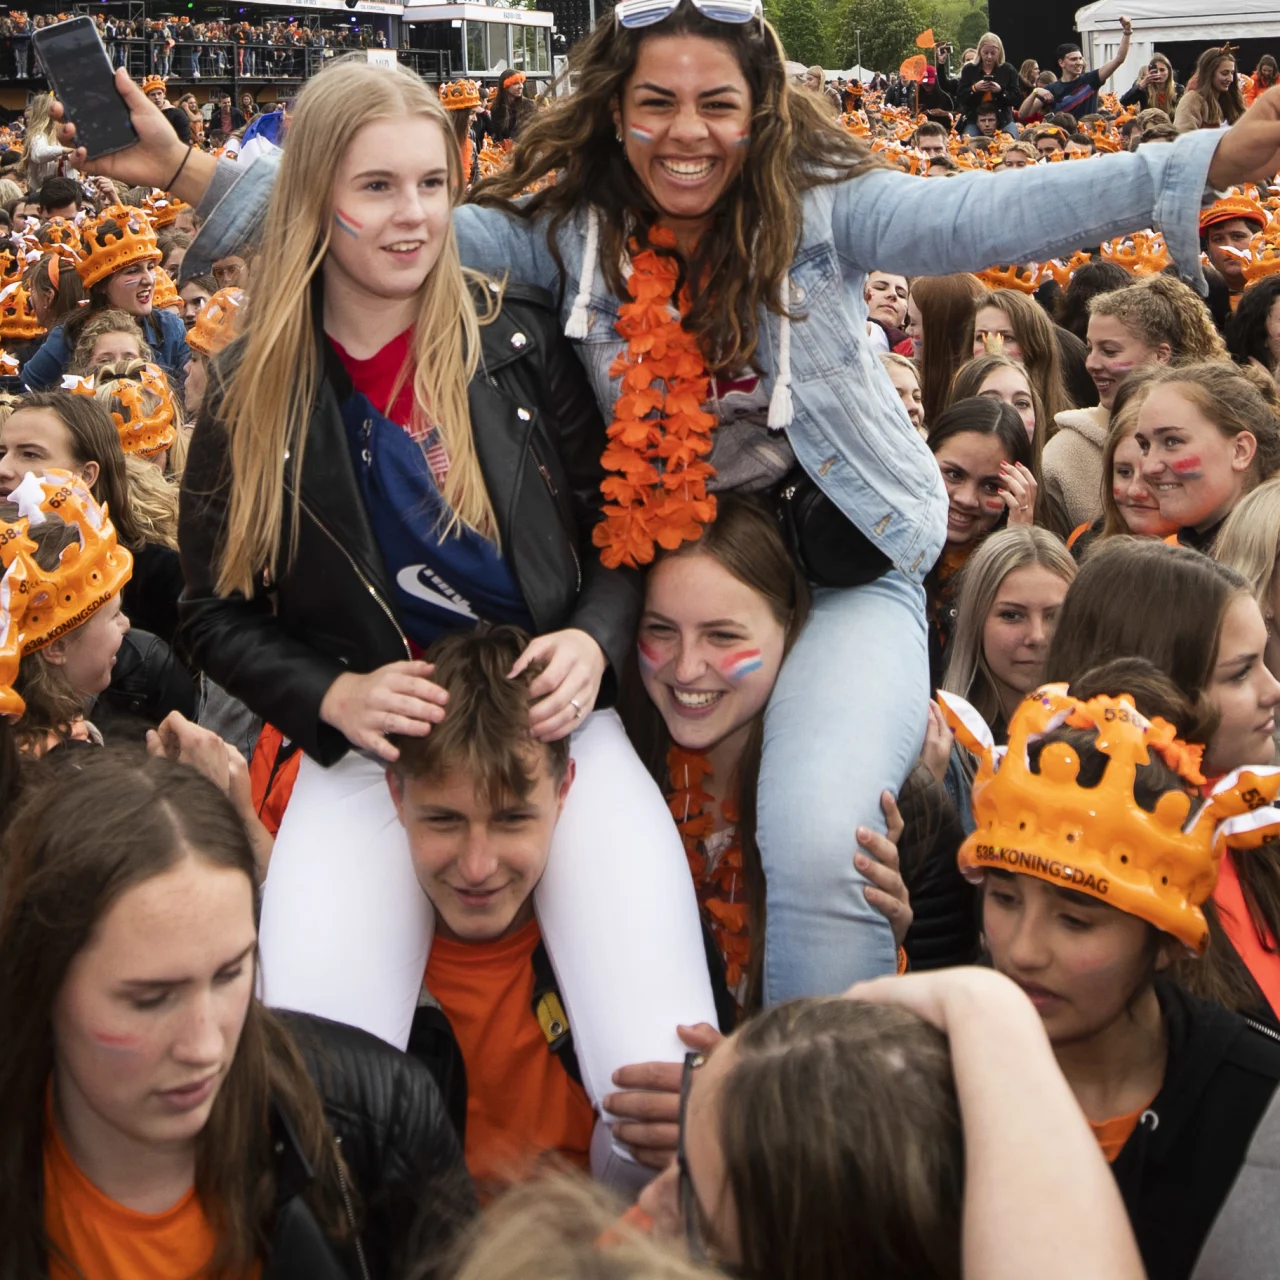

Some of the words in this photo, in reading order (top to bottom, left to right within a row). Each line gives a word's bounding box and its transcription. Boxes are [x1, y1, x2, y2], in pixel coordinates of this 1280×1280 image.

[48, 487, 72, 510] 538
[23, 637, 45, 654] 538
[47, 590, 112, 639] KONINGSDAG
[975, 843, 996, 860] 538
[999, 847, 1110, 896] KONINGSDAG
